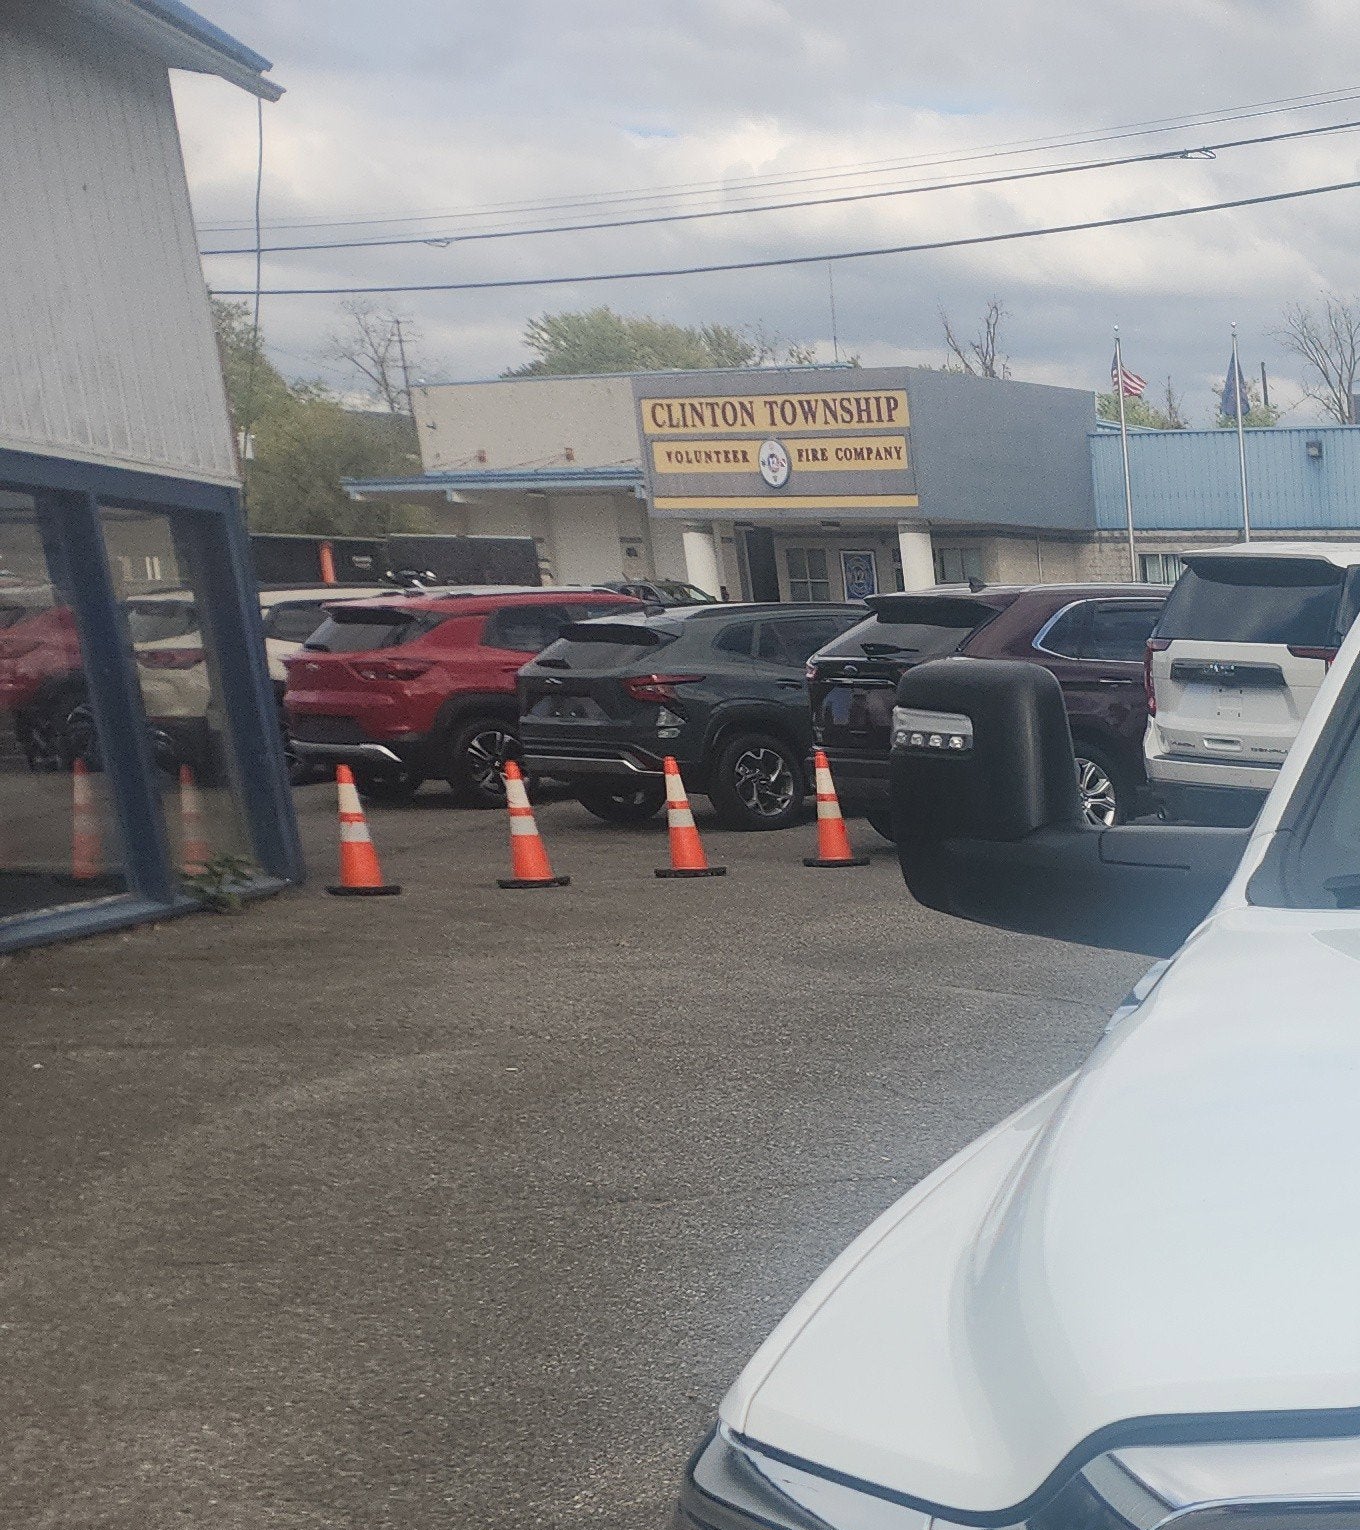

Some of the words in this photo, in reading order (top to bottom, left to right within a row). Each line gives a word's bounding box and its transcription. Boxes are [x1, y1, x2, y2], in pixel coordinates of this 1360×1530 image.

[651, 399, 756, 428] CLINTON
[764, 396, 899, 427] TOWNSHIP
[665, 450, 750, 464] VOLUNTEER
[797, 447, 828, 462] FIRE
[835, 445, 902, 461] COMPANY
